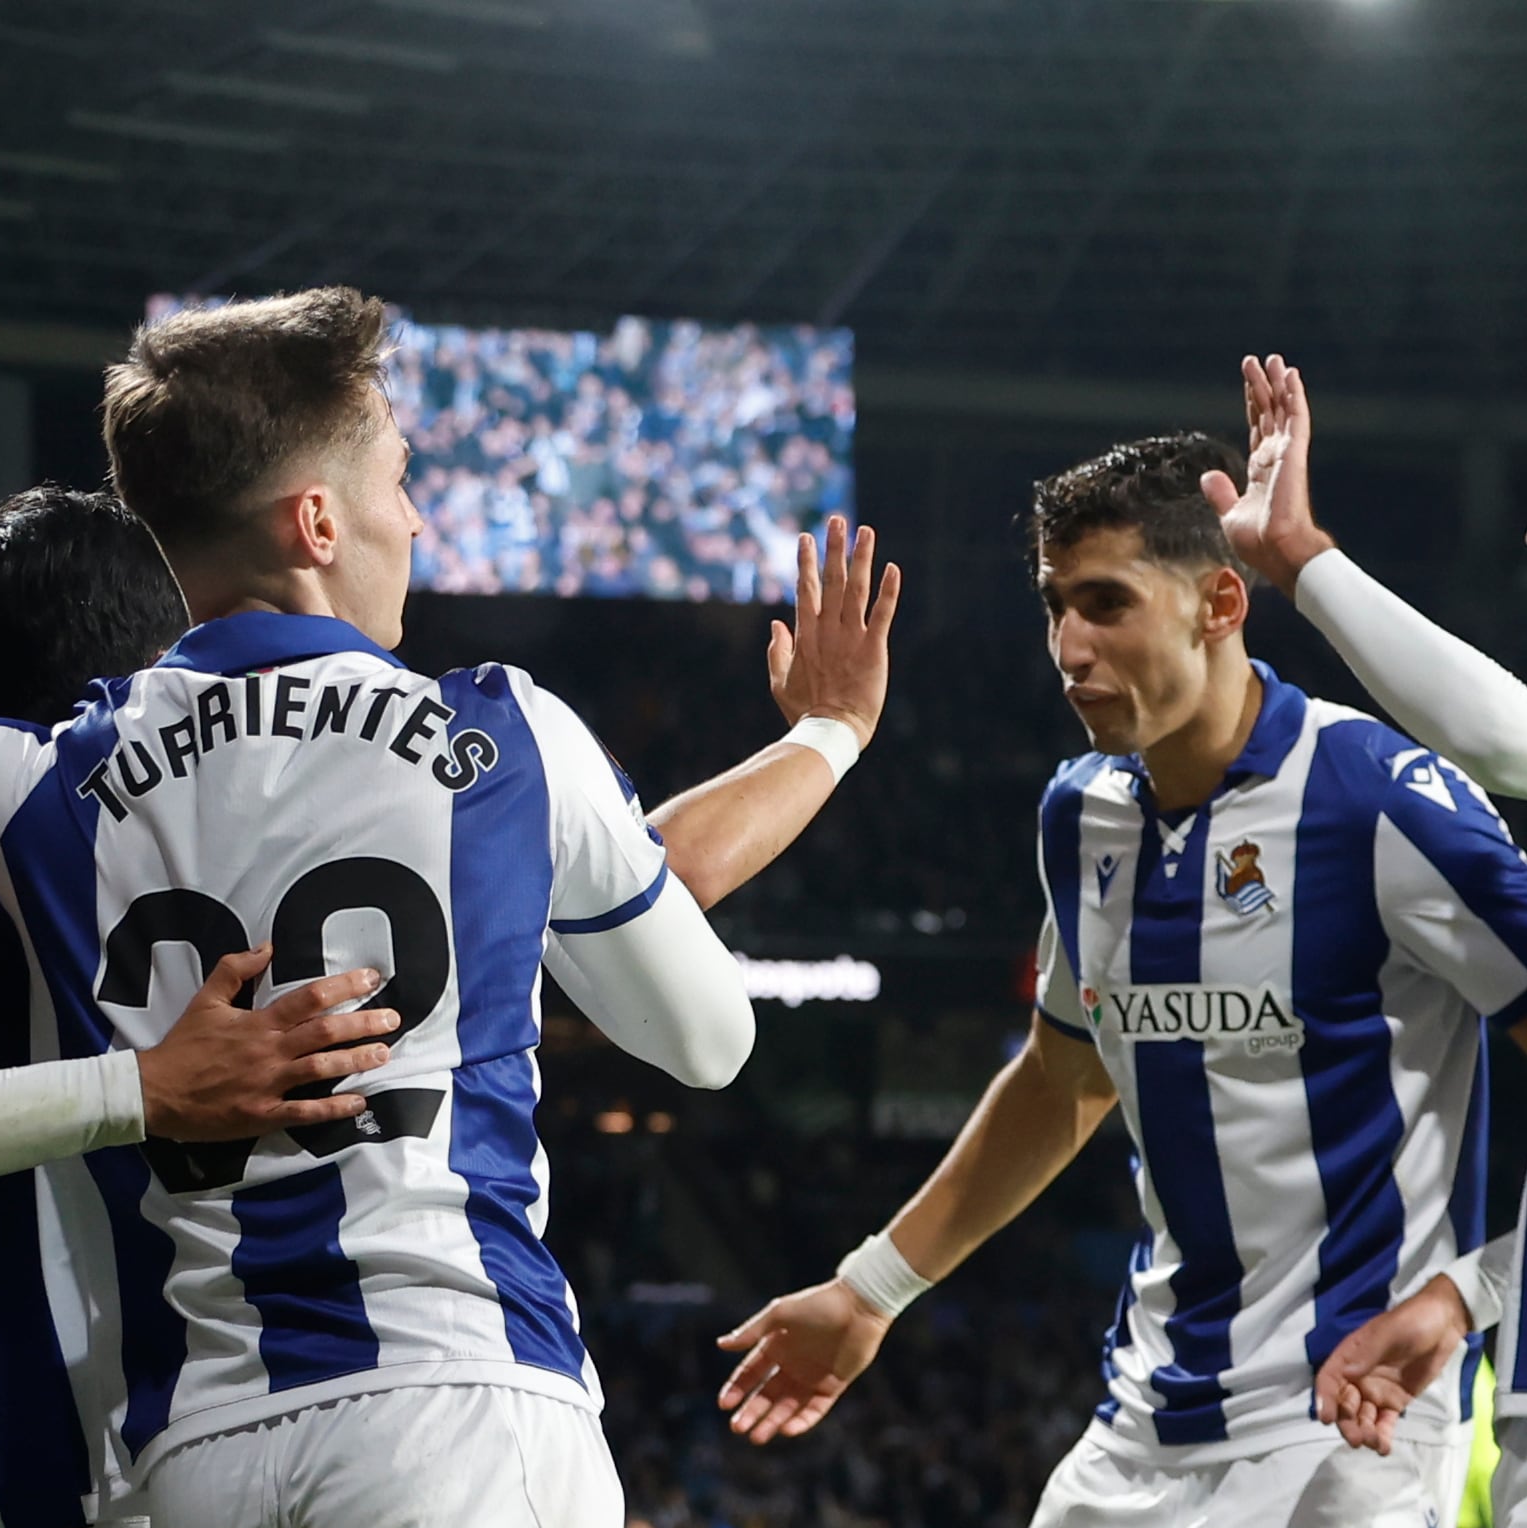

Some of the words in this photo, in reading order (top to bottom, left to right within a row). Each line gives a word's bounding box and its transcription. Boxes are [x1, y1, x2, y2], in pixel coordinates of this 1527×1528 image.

[78, 674, 498, 824] TURRIENTES
[1109, 989, 1295, 1035] YASUDA
[1248, 1032, 1300, 1055] group
